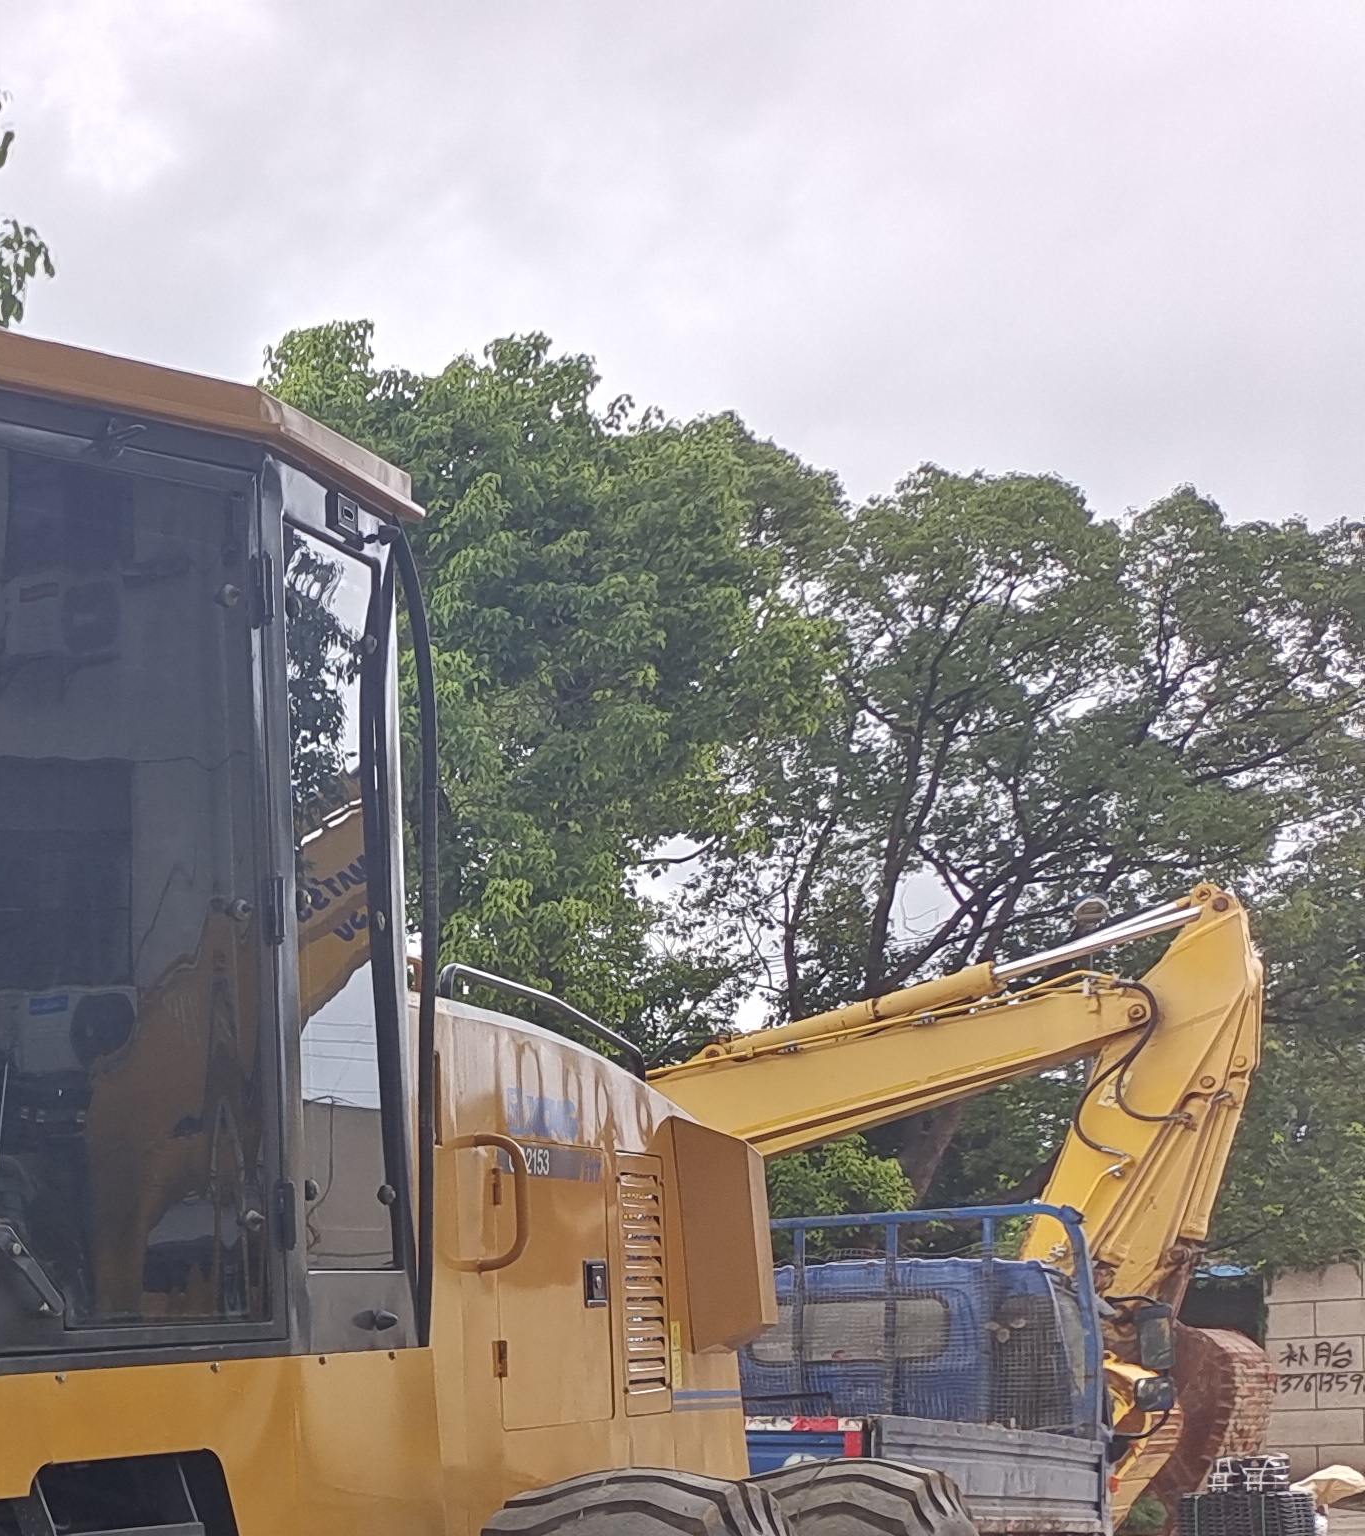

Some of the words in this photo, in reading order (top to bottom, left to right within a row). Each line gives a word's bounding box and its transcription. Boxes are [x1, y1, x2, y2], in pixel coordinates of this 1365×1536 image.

[508, 1146, 550, 1176] 2153
[1279, 1341, 1353, 1369] 补胎
[1272, 1373, 1365, 1395] 13761359
